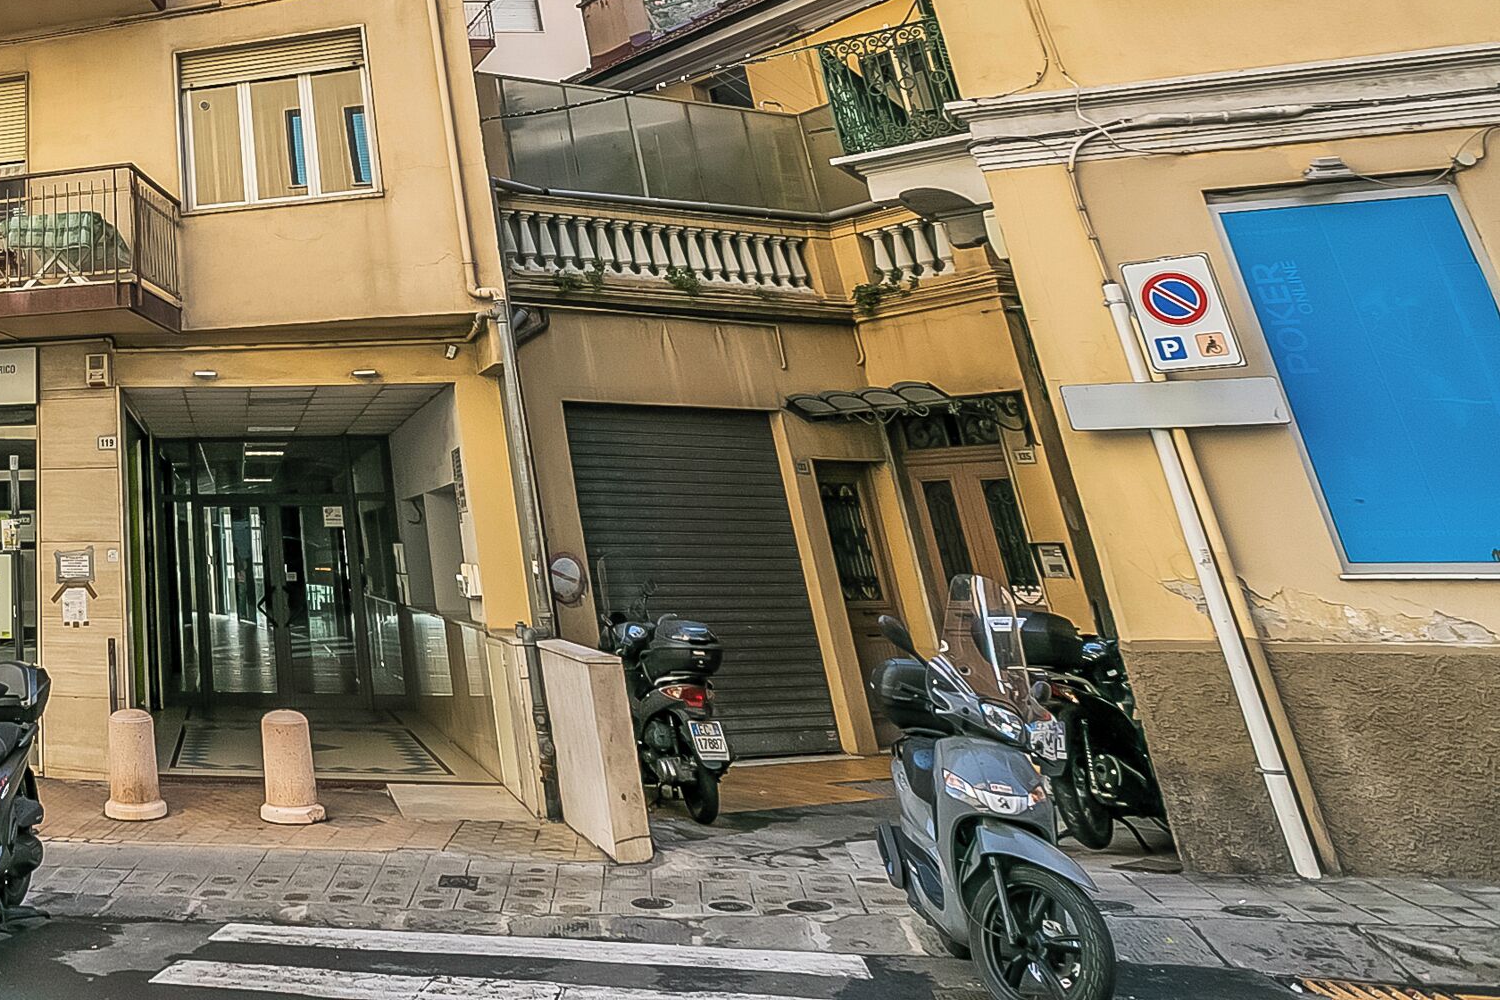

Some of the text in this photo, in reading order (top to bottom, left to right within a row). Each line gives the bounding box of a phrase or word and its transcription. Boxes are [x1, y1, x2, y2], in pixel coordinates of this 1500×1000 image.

[1282, 260, 1313, 314] ONLINE
[1251, 263, 1319, 374] POKER
[1160, 339, 1180, 358] P
[100, 438, 114, 447] 119
